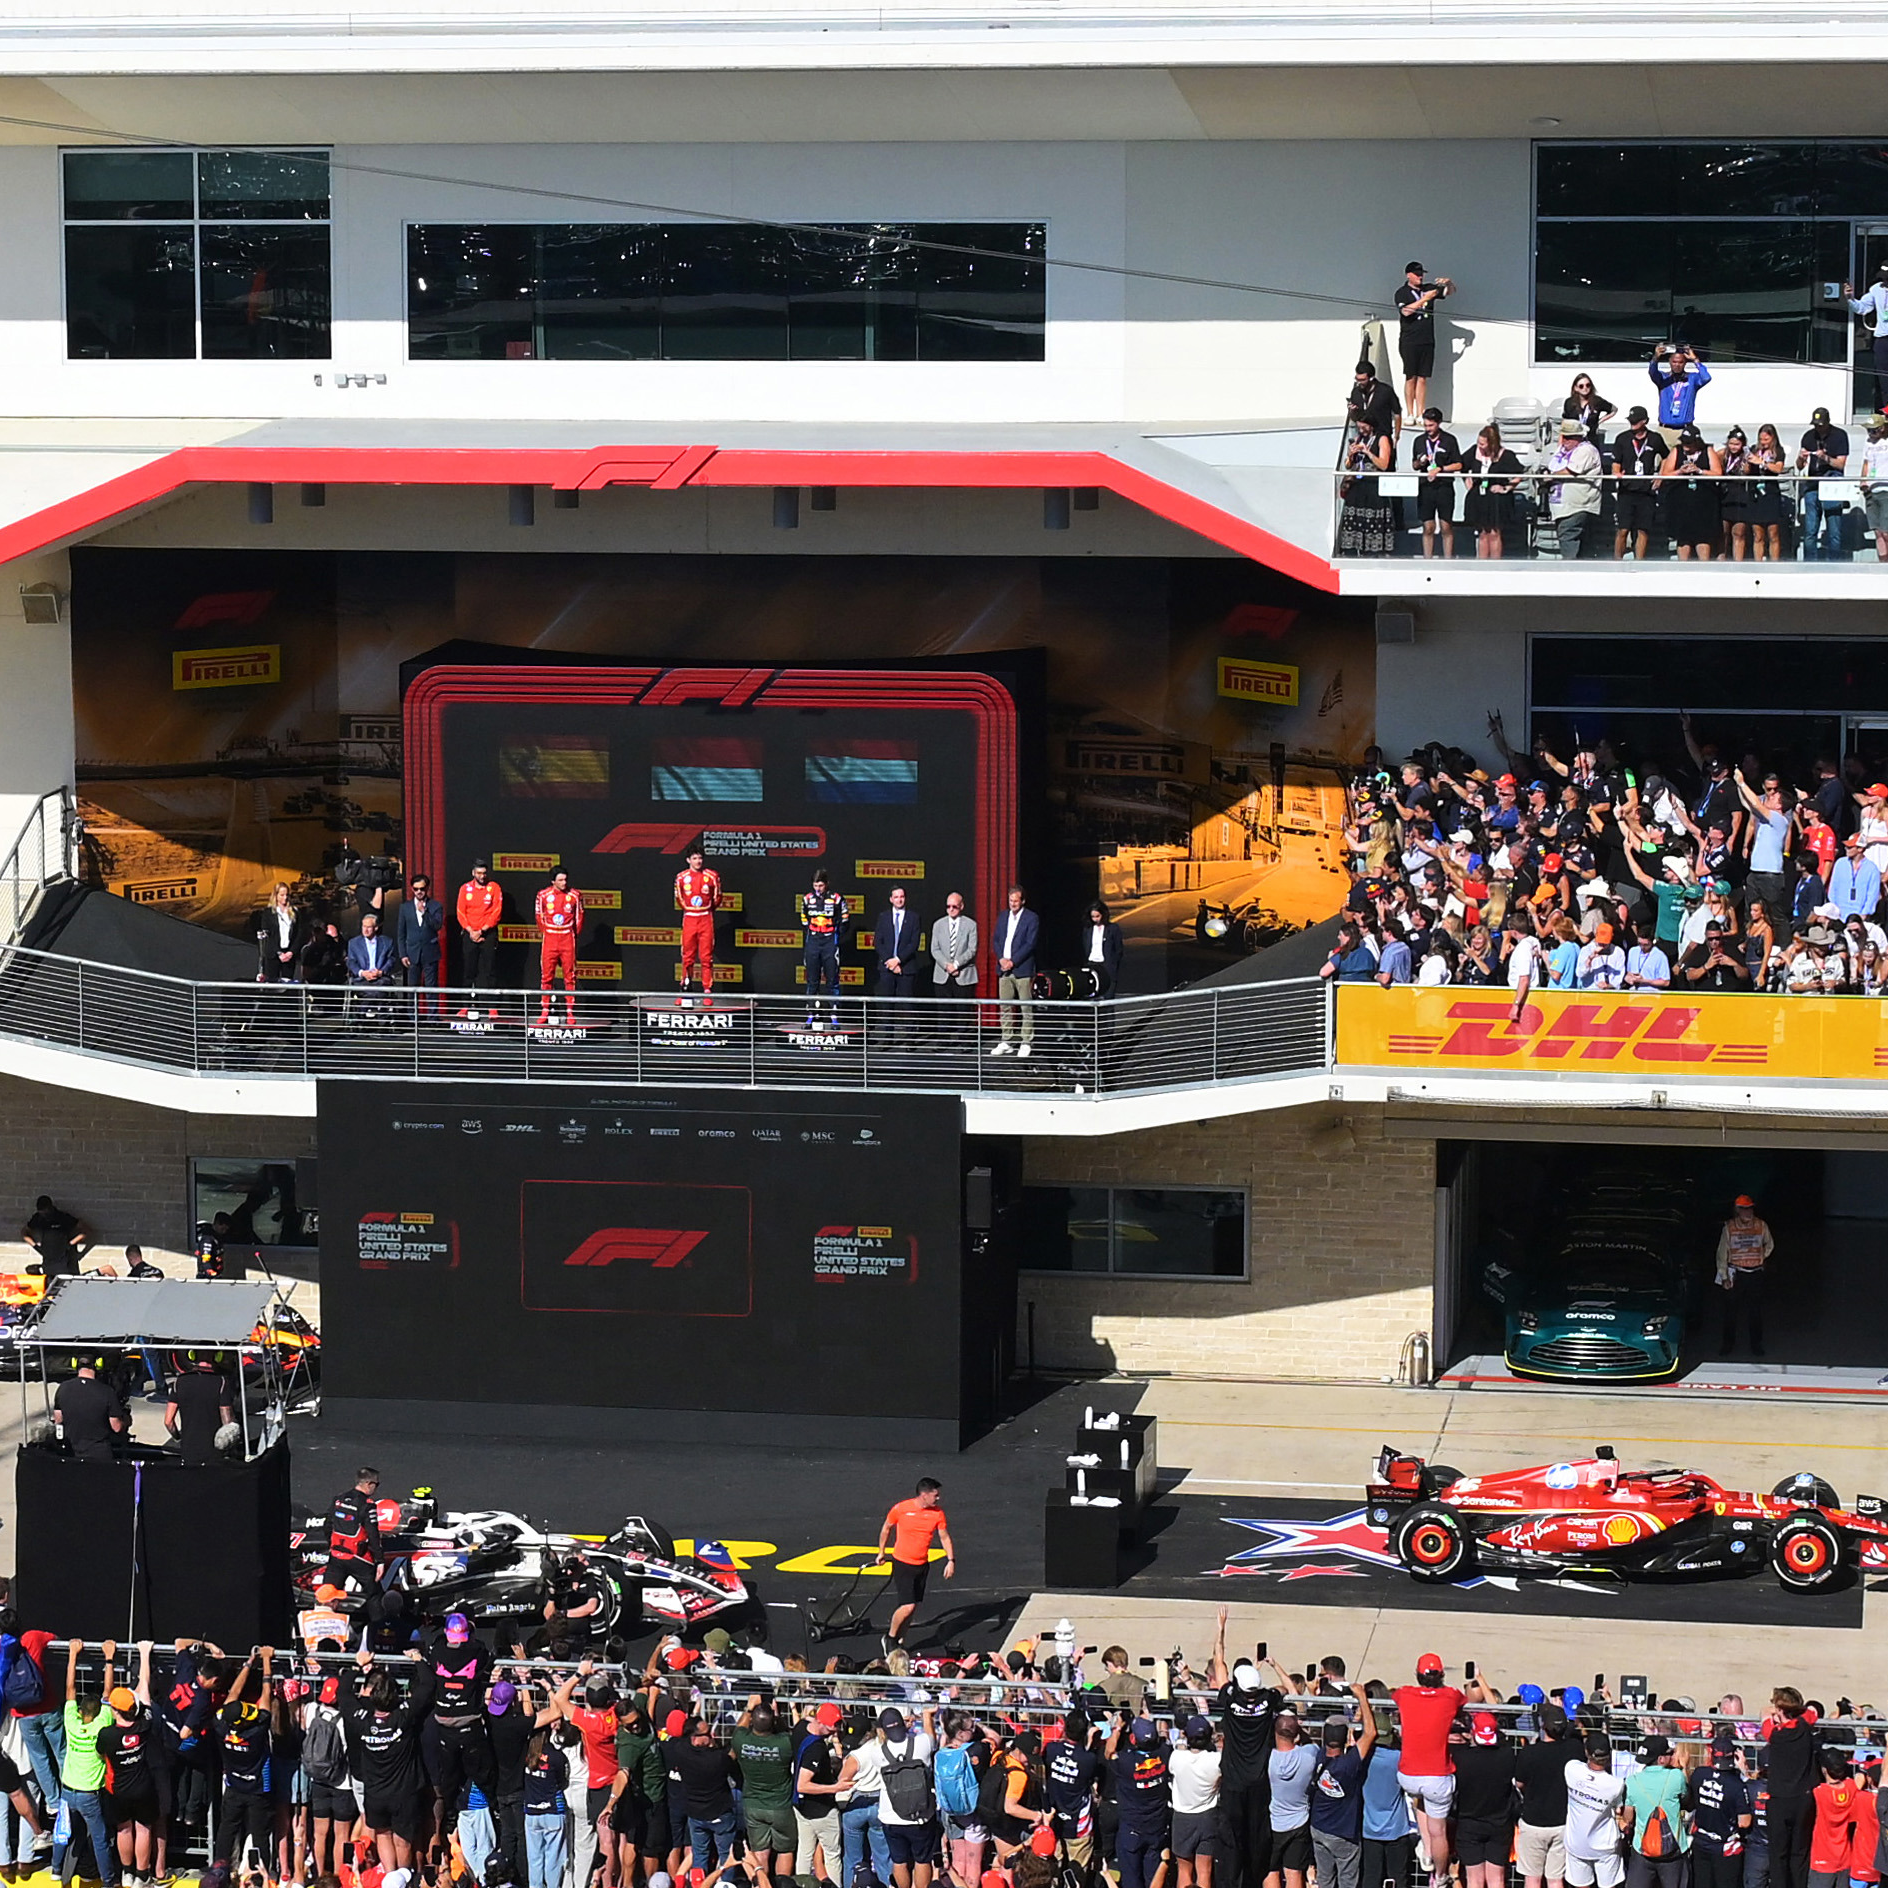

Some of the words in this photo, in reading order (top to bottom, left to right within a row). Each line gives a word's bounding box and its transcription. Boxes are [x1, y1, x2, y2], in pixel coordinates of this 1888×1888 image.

[182, 652, 271, 682] PIRELLI
[1224, 665, 1291, 698] PIRELLI
[340, 714, 400, 740] PIRE
[1065, 739, 1184, 775] PIRELLI
[703, 831, 752, 840] FORMULA
[754, 831, 762, 840] 1
[703, 840, 739, 848] PIRELLI
[742, 840, 778, 849] UNITED
[780, 840, 819, 849] STATES
[704, 848, 742, 856] GRAND
[744, 848, 766, 856] PRIX
[123, 878, 197, 901] PIRELLI
[647, 1013, 733, 1029] FERRARI
[450, 1022, 494, 1032] FERRARI
[1439, 1002, 1716, 1062] DHL
[527, 1028, 586, 1039] FERRARI
[788, 1034, 848, 1046] FERRARI
[403, 1121, 444, 1130] crypto.com
[462, 1120, 481, 1129] aws
[605, 1127, 633, 1135] ROLEX
[698, 1129, 735, 1138] aramco
[752, 1129, 781, 1138] QATAR
[812, 1131, 835, 1140] MSC
[359, 1223, 416, 1233] FORMULA
[418, 1224, 426, 1233] 1
[359, 1232, 401, 1241] PIRELLI
[814, 1237, 874, 1247] FORMULA
[875, 1238, 883, 1247] 1
[359, 1241, 402, 1251] UNITED
[403, 1243, 447, 1252] STATES
[814, 1247, 858, 1256] PIRELLI
[1567, 1242, 1602, 1250] ASTON
[1605, 1242, 1647, 1251] MARTIN
[359, 1251, 401, 1260] GRAND
[403, 1252, 431, 1261] PRIX
[814, 1256, 858, 1266] UNITED
[860, 1257, 905, 1267] STATES
[814, 1265, 857, 1274] GRAND
[859, 1266, 888, 1275] PRIX
[1566, 1312, 1615, 1321] aramco
[1462, 1495, 1516, 1508] Santander
[1858, 1498, 1881, 1510] aws
[1502, 1513, 1559, 1547] Ray-Ban
[486, 1603, 507, 1613] Palm
[509, 1602, 536, 1613] Angels
